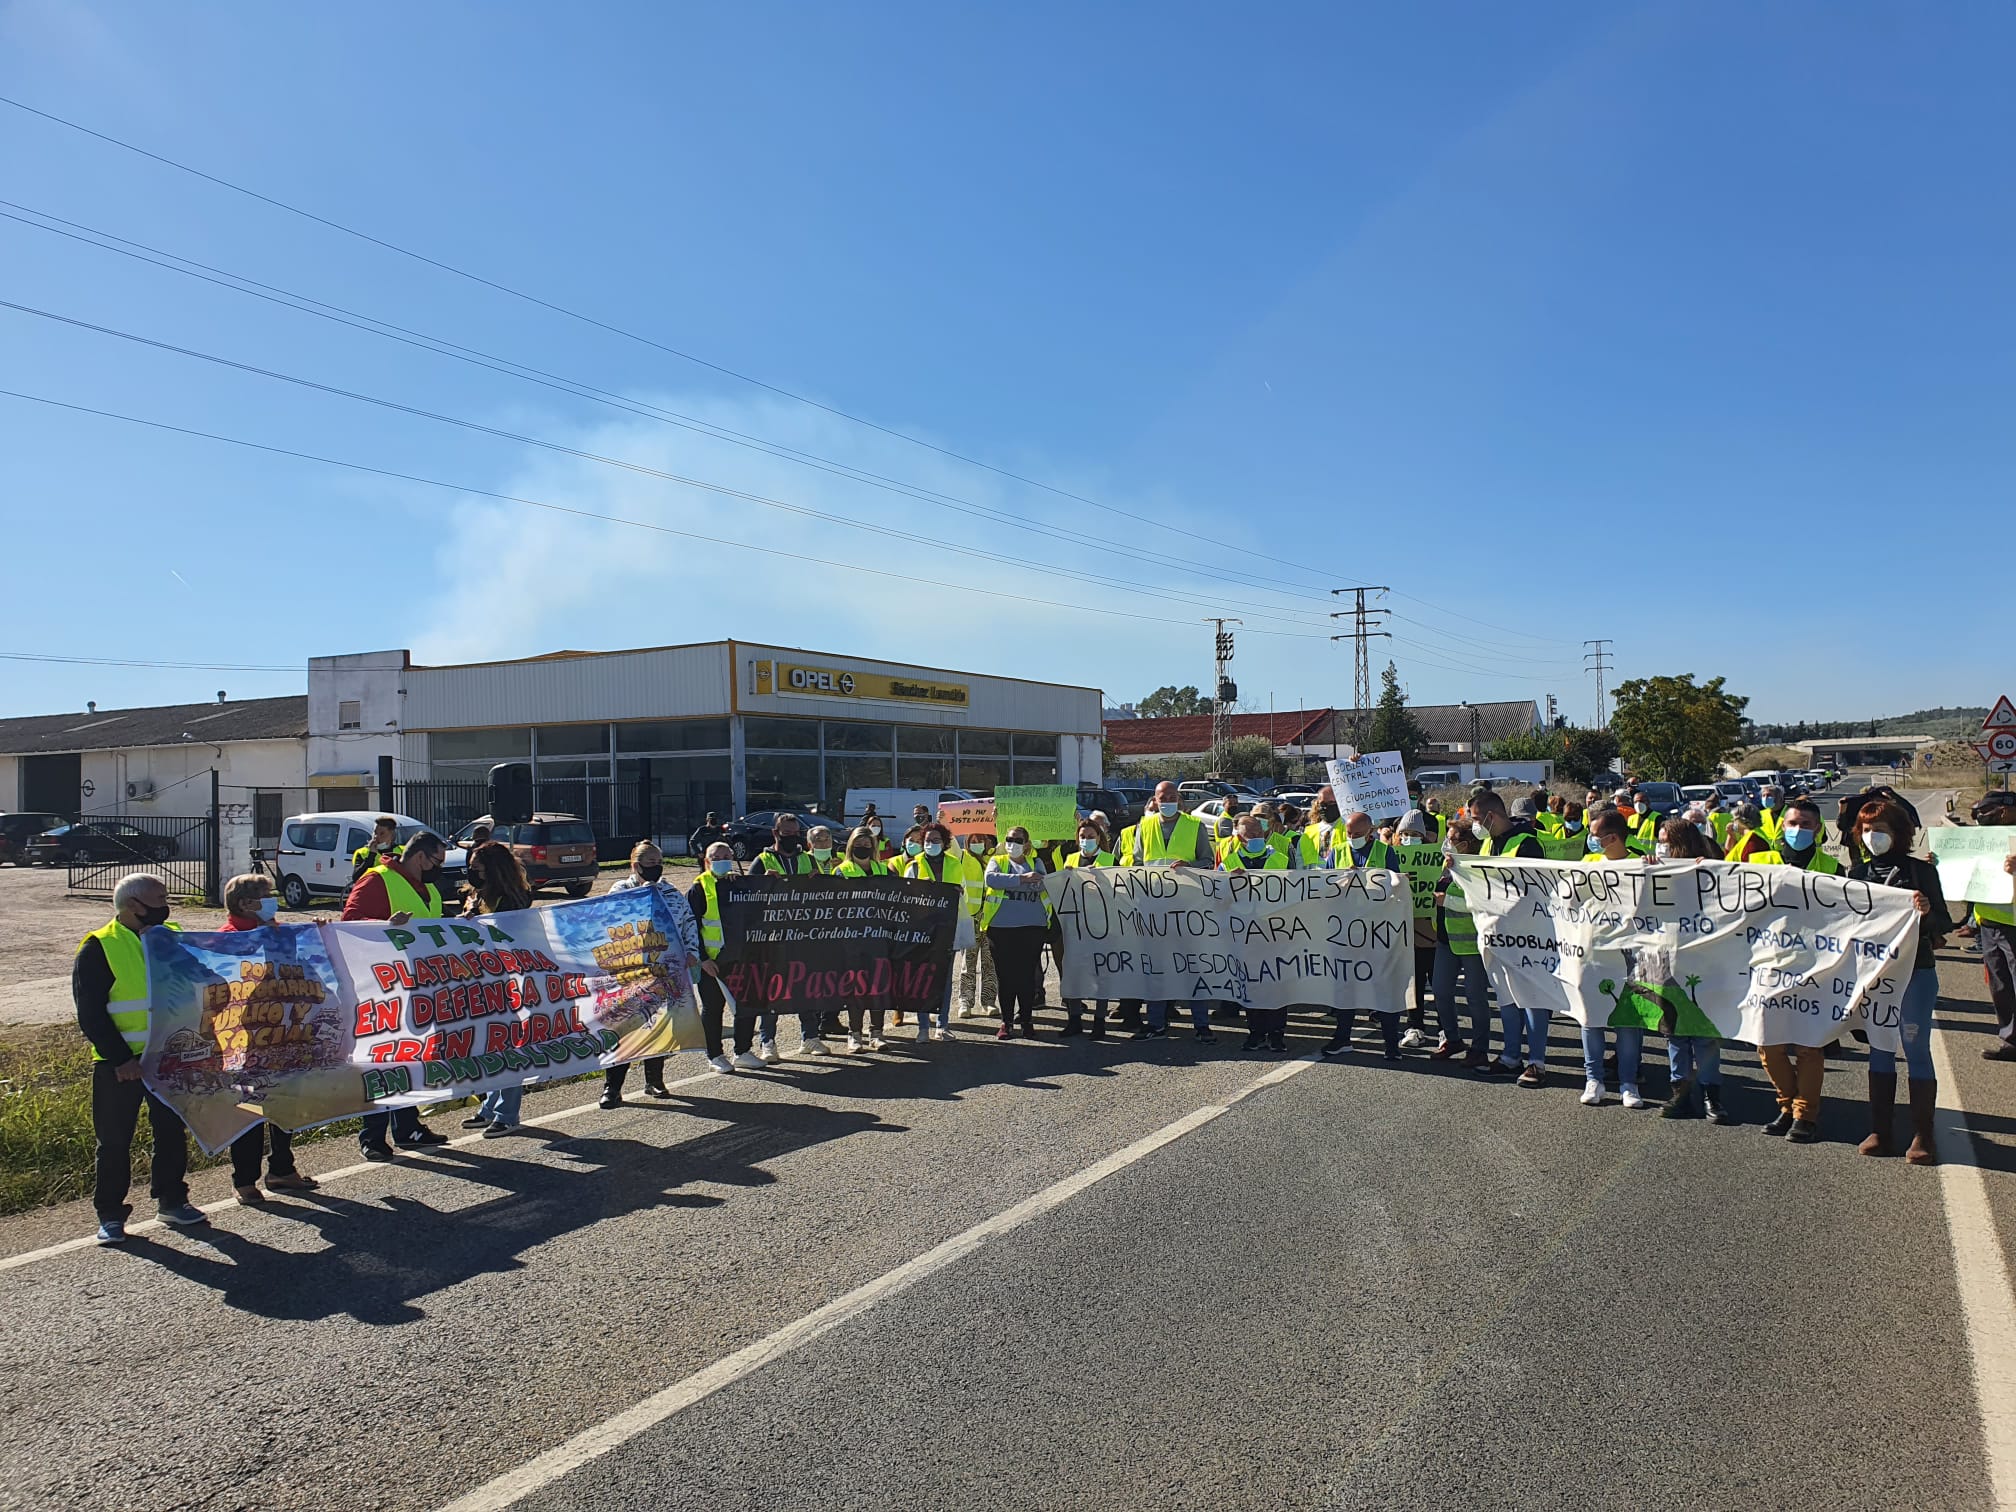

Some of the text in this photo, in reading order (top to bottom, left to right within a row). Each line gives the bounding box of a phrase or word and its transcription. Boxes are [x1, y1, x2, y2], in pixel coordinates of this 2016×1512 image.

[791, 669, 840, 691] OPEL
[1995, 740, 2014, 749] 60
[1333, 756, 1381, 775] GOBIERNO
[1375, 764, 1404, 776] JUNTA
[1346, 786, 1400, 804] CIUDADANOS
[1362, 799, 1407, 813] SEGUNDA
[766, 893, 788, 905] para
[791, 889, 801, 902] la
[801, 890, 834, 904] puesta
[837, 891, 849, 900] en
[851, 889, 885, 901] marcha
[888, 890, 901, 903] del
[902, 894, 935, 907] servicio
[937, 897, 949, 908] de
[1470, 864, 1873, 915] TRANSPORTE PÚBLICO
[763, 906, 911, 923] TRENES DE CERCANÍAS:
[1057, 877, 1110, 941] 40
[1113, 869, 1179, 900] AÑOS
[1199, 874, 1223, 900] DE
[1229, 873, 1388, 903] PROMESAS
[607, 922, 634, 940] POR
[1117, 907, 1220, 938] MINUTOS
[1229, 916, 1312, 945] PARA
[1633, 916, 1665, 934] DEL
[383, 924, 516, 951] PTRA
[745, 929, 767, 943] Villa
[768, 929, 783, 942] del
[894, 930, 909, 942] del
[1815, 934, 1844, 954] DEL
[240, 960, 275, 979] POR
[372, 949, 560, 993] PLATAFORMA
[1093, 950, 1135, 976] POR
[1140, 953, 1165, 975] EL
[203, 979, 326, 1009] FERROCARRIL
[291, 1001, 312, 1023] Y
[353, 972, 591, 1037] EN DEFENSA DEL
[369, 1006, 591, 1064] TREN RURAL
[363, 1066, 412, 1102] EN
[409, 1130, 422, 1141] N
